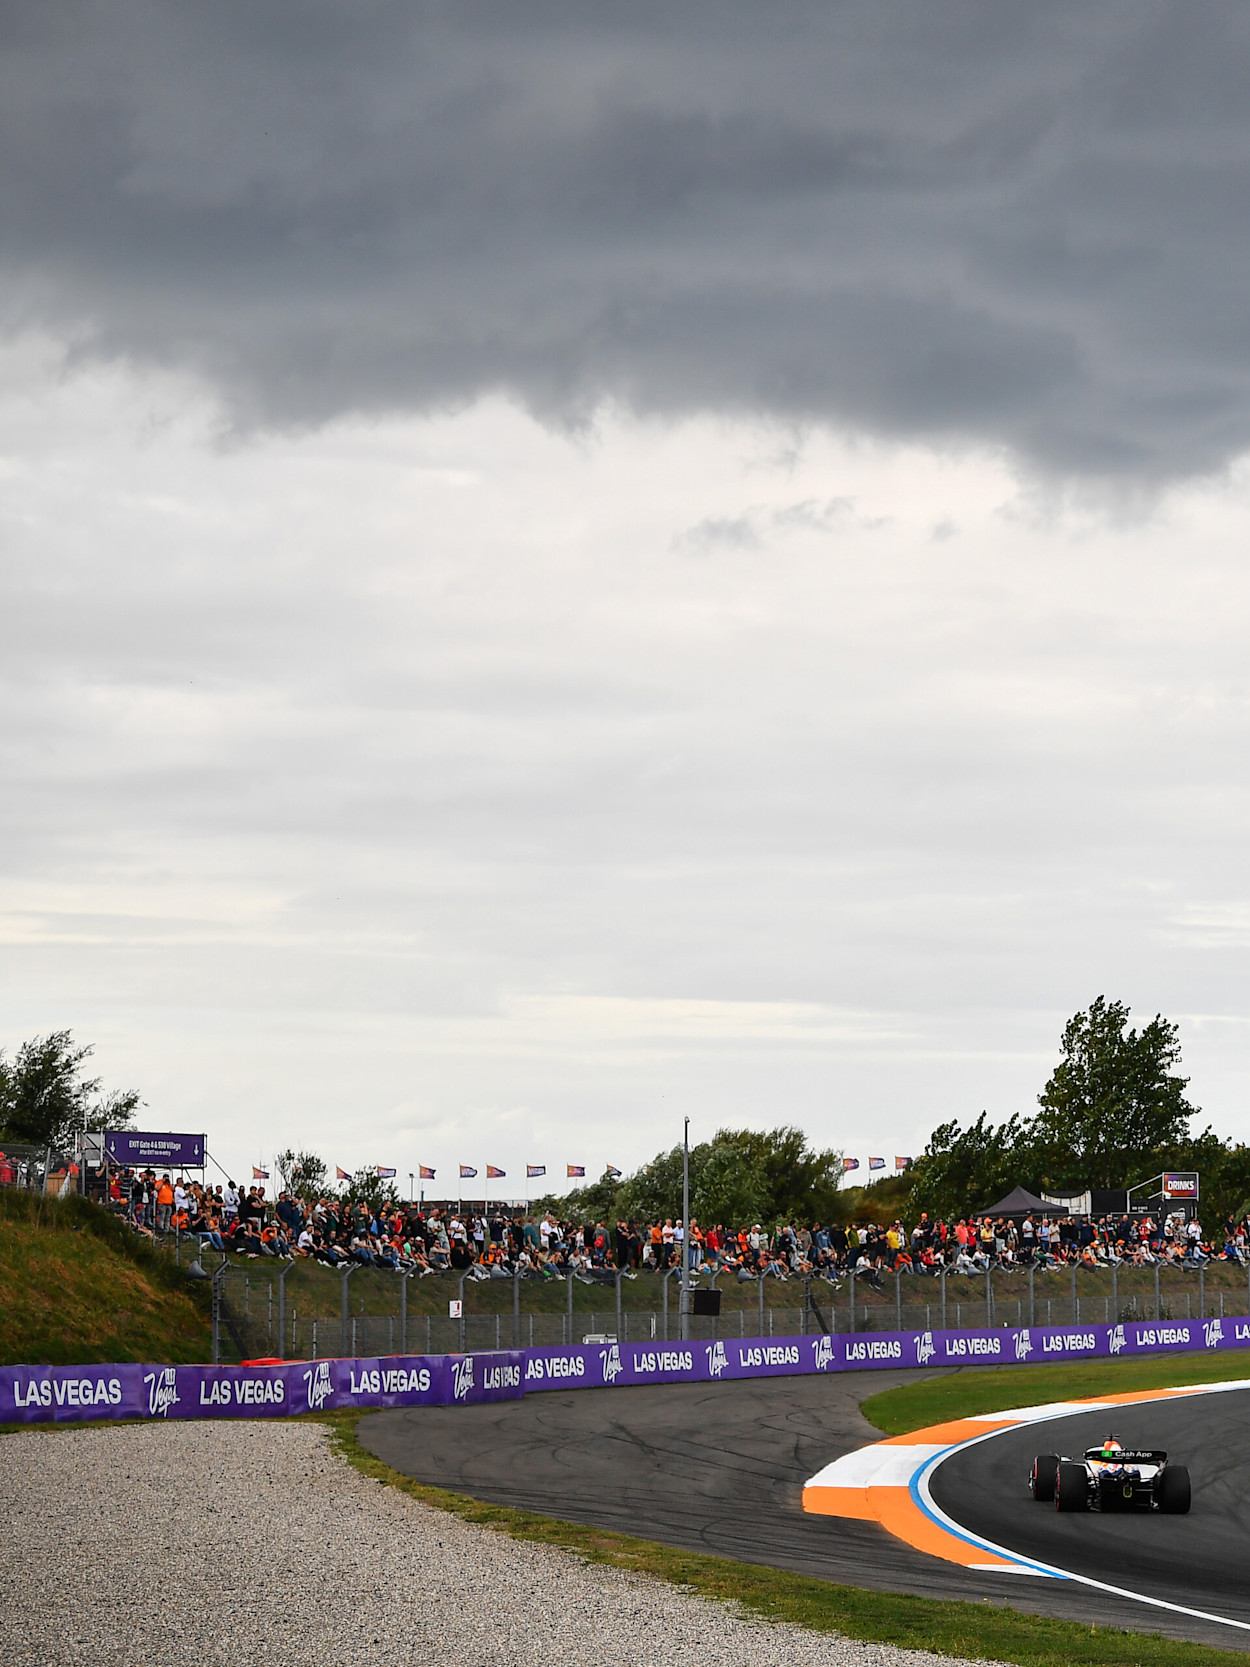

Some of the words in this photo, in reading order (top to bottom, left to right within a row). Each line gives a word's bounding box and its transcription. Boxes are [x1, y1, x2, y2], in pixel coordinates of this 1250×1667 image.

[129, 1140, 139, 1148] EXIT
[140, 1141, 150, 1149] Gate
[167, 1142, 181, 1151] Village
[1167, 1181, 1195, 1190] DRINKS
[946, 1339, 969, 1355] LAS
[969, 1338, 1000, 1354] VEGAS
[1043, 1336, 1064, 1351] LAS
[1064, 1334, 1095, 1350] VEGAS
[1137, 1330, 1158, 1345] LAS
[1158, 1328, 1189, 1344] VEGAS
[740, 1349, 761, 1366] LAS
[761, 1346, 799, 1365] VEGAS
[846, 1343, 868, 1360] LAS
[868, 1341, 901, 1358] VEGAS
[525, 1359, 543, 1379] AS
[545, 1356, 584, 1377] VEGAS
[634, 1353, 655, 1372] LAS
[657, 1352, 692, 1370] VEGAS
[350, 1371, 380, 1393] LAS
[382, 1369, 430, 1392] VEGAS
[484, 1368, 500, 1388] LAS
[15, 1380, 51, 1406] LAS
[53, 1379, 121, 1405] VEGAS
[200, 1381, 231, 1404] LAS
[235, 1380, 283, 1403] VEGAS
